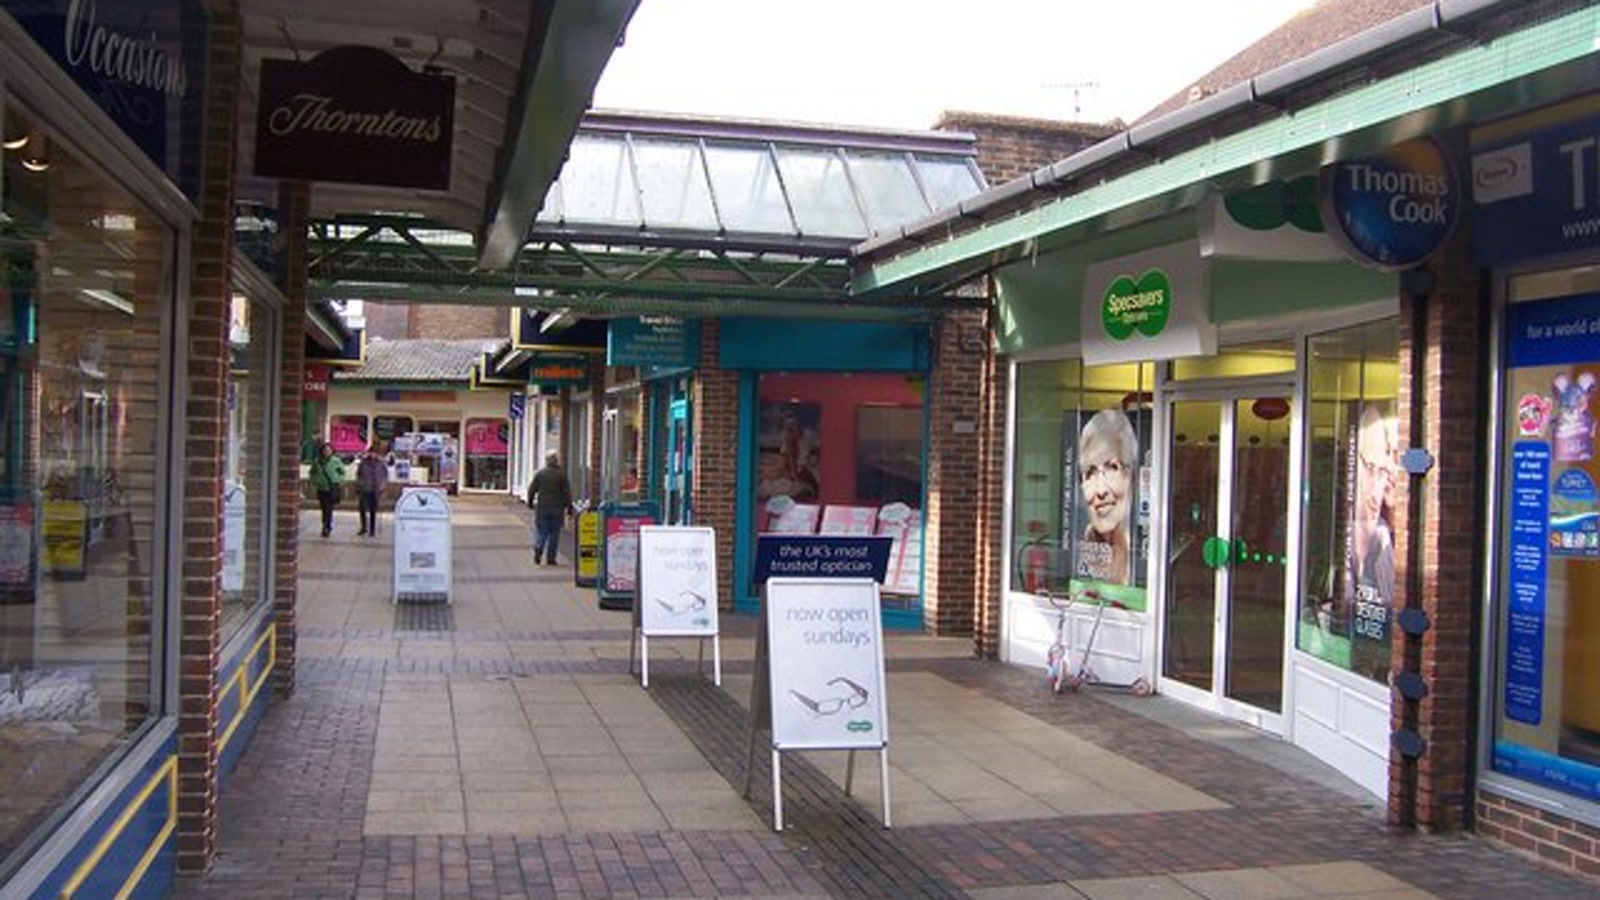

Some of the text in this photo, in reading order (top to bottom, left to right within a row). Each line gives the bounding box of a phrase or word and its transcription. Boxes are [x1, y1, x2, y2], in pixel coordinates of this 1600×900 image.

[64, 0, 187, 98] Occasions
[269, 94, 442, 143] Thorntons
[1345, 163, 1449, 196] Thomas
[1559, 136, 1600, 210] T
[1388, 194, 1451, 225] Cook
[1107, 289, 1164, 316] Specsavers
[1555, 318, 1587, 336] world
[1589, 315, 1600, 333] o
[780, 544, 869, 559] the UK's most
[769, 559, 873, 573] trusted optician
[786, 608, 869, 625] now open
[802, 627, 871, 648] sundays
